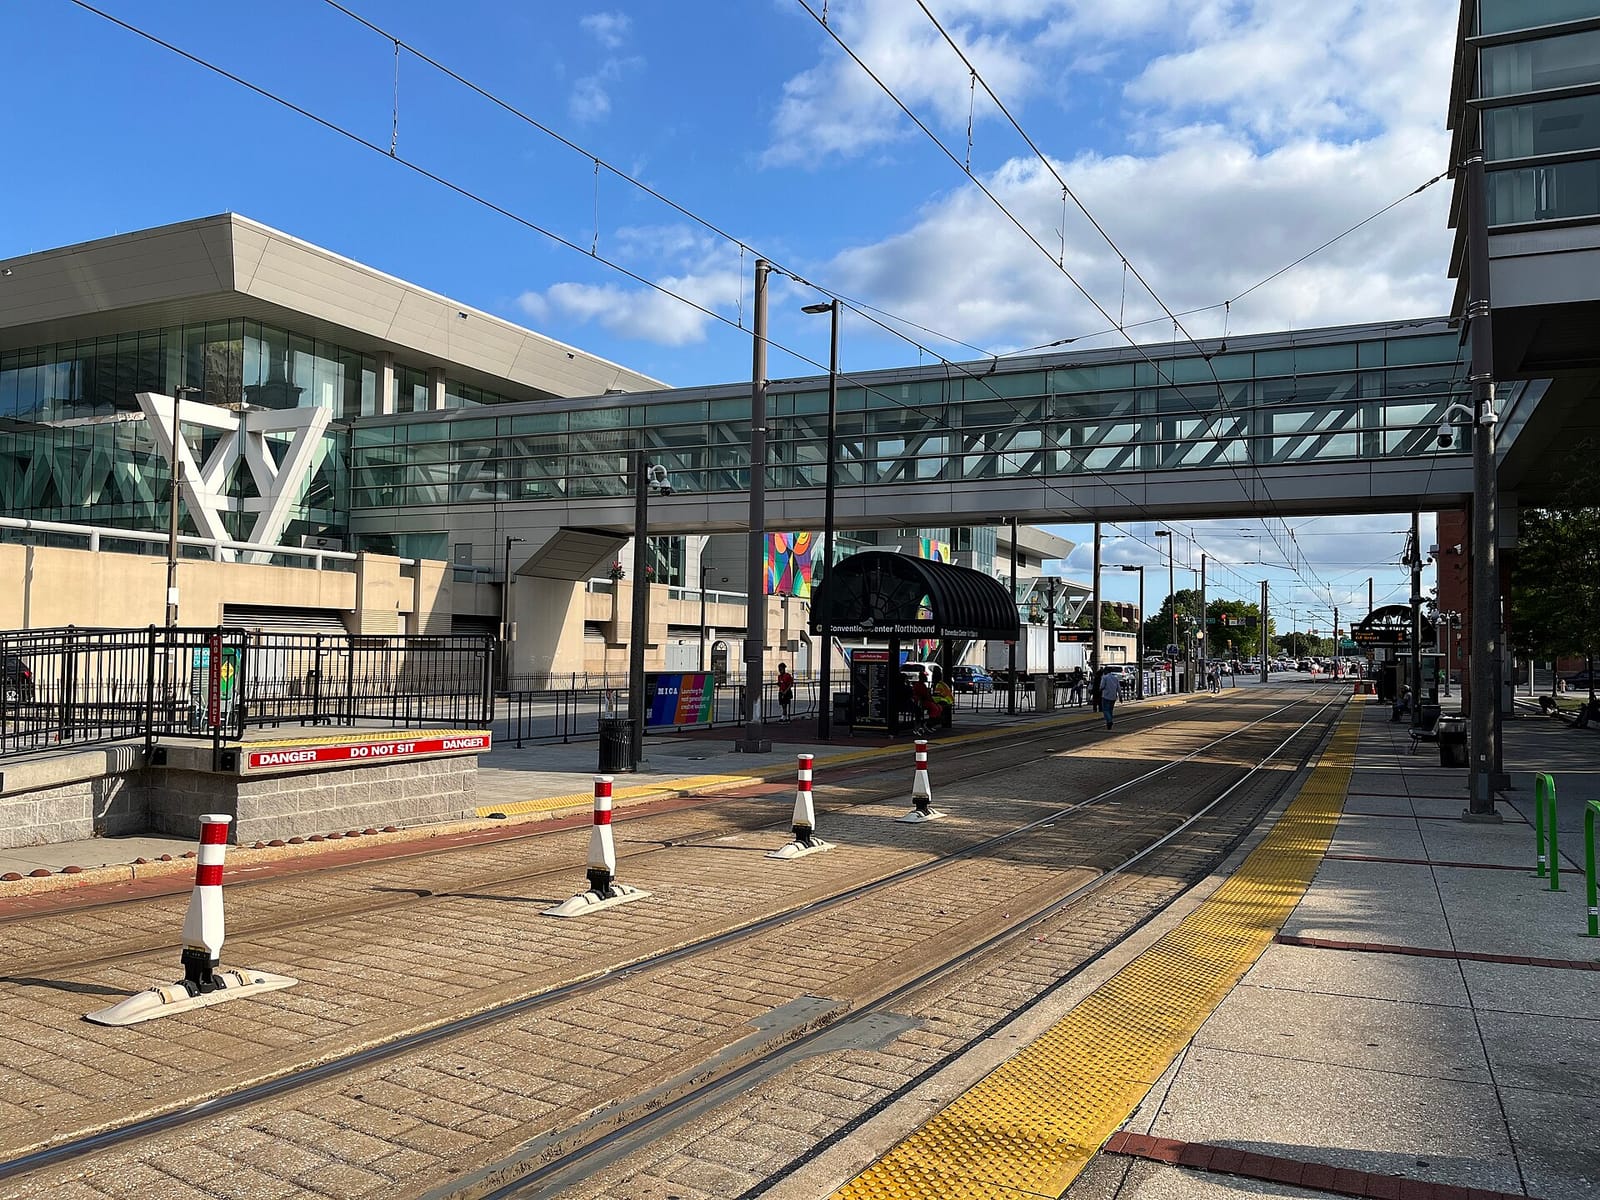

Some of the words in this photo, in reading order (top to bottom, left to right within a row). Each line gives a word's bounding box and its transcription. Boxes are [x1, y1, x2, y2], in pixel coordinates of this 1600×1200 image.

[830, 624, 866, 633] onventio
[870, 625, 893, 633] enter
[894, 624, 935, 634] Northbound
[213, 639, 219, 653] NO
[657, 687, 678, 695] MICA
[350, 747, 370, 758] DO
[371, 745, 396, 756] NOT
[397, 743, 415, 753] SIT
[443, 738, 484, 750] DANGER
[259, 751, 317, 765] DANGER
